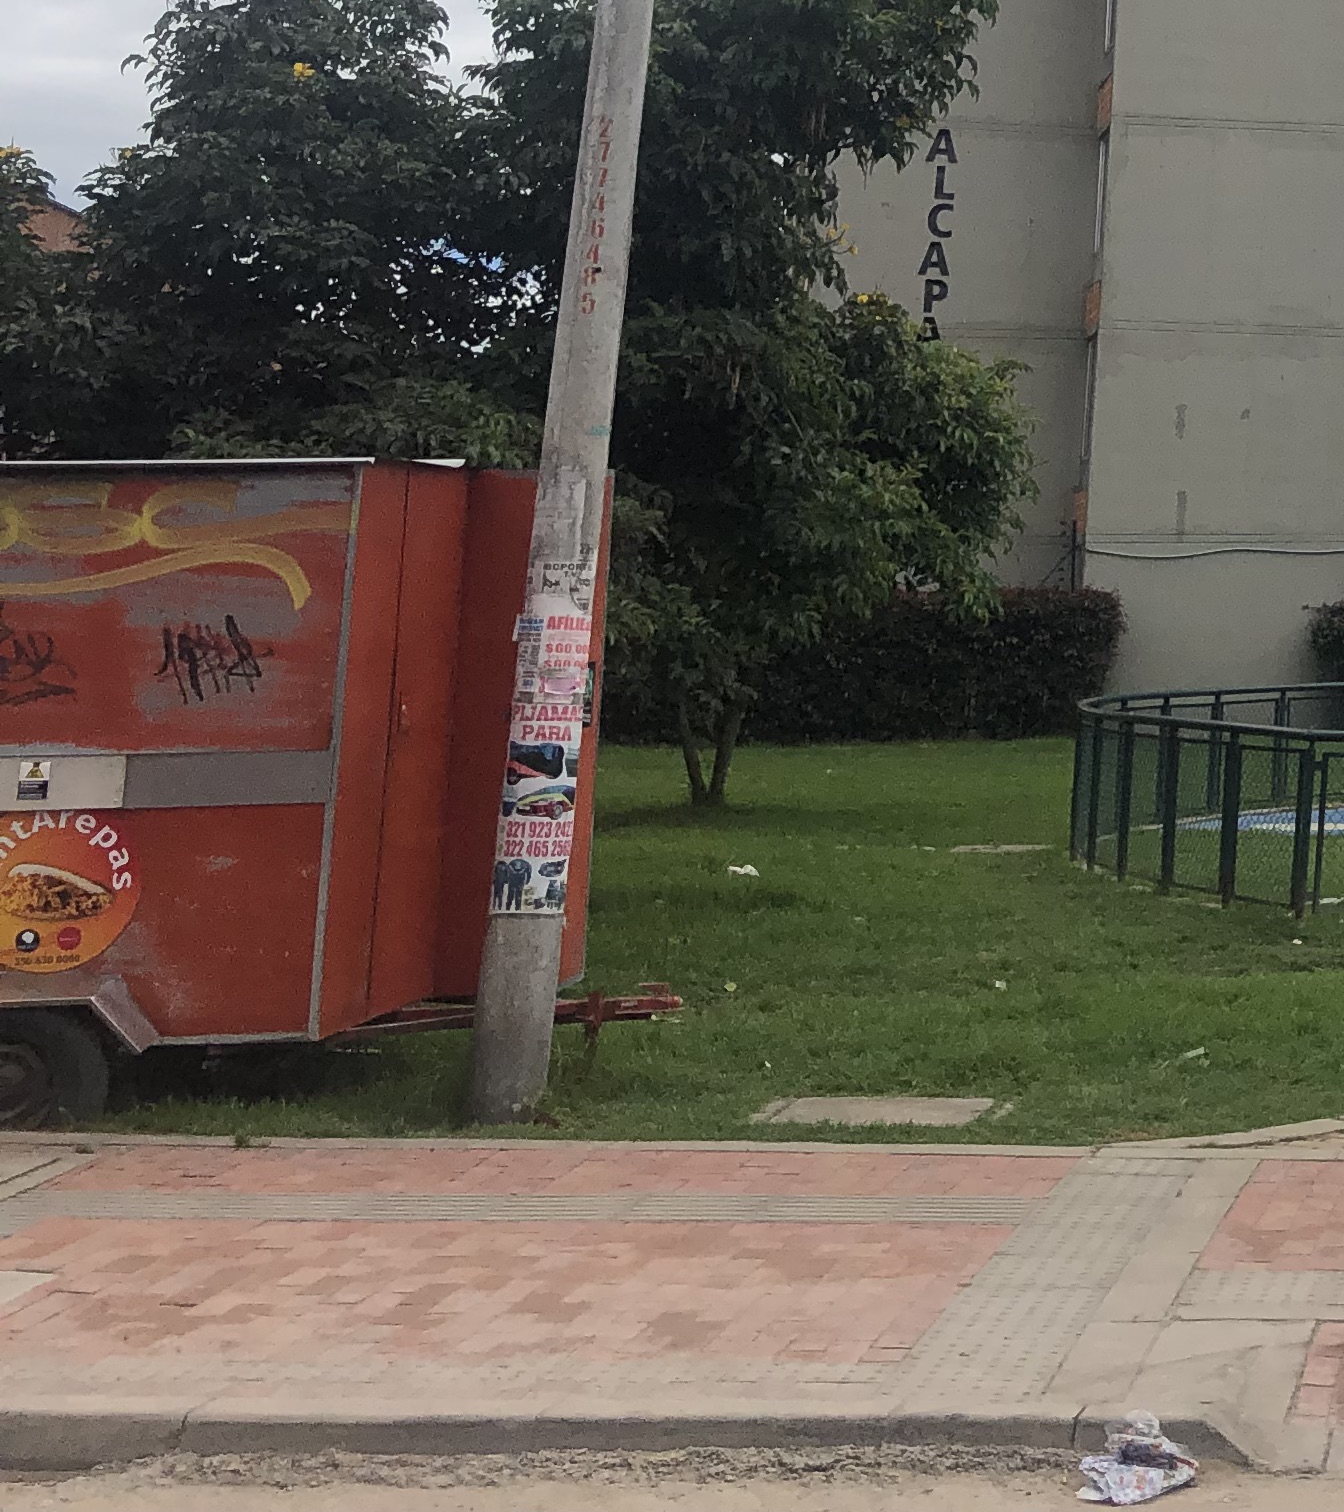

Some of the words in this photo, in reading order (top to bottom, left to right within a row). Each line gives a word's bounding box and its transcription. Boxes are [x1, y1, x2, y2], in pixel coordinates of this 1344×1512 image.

[512, 704, 582, 721] PIJAMA
[522, 724, 572, 741] PARA
[506, 821, 526, 838] 321
[528, 821, 553, 838] 923
[504, 840, 524, 857] 322
[526, 840, 549, 857] 465
